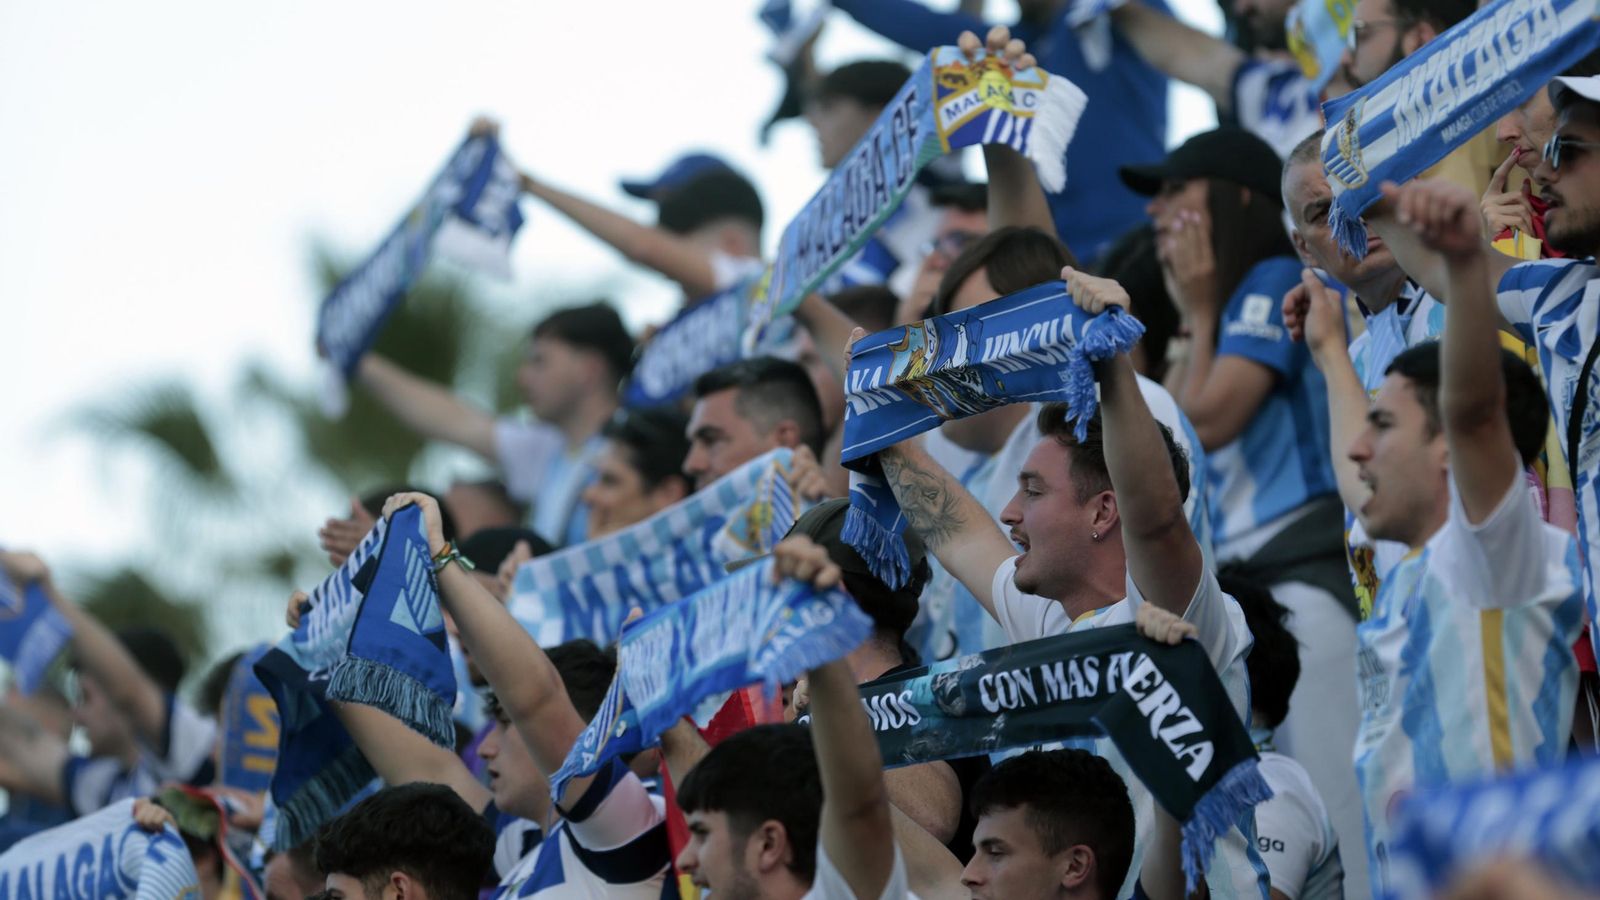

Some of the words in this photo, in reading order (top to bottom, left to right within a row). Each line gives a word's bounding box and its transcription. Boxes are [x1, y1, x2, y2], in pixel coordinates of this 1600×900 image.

[978, 666, 1039, 713] CON
[1040, 654, 1100, 703] MÁS
[1106, 651, 1215, 783] FUERZA
